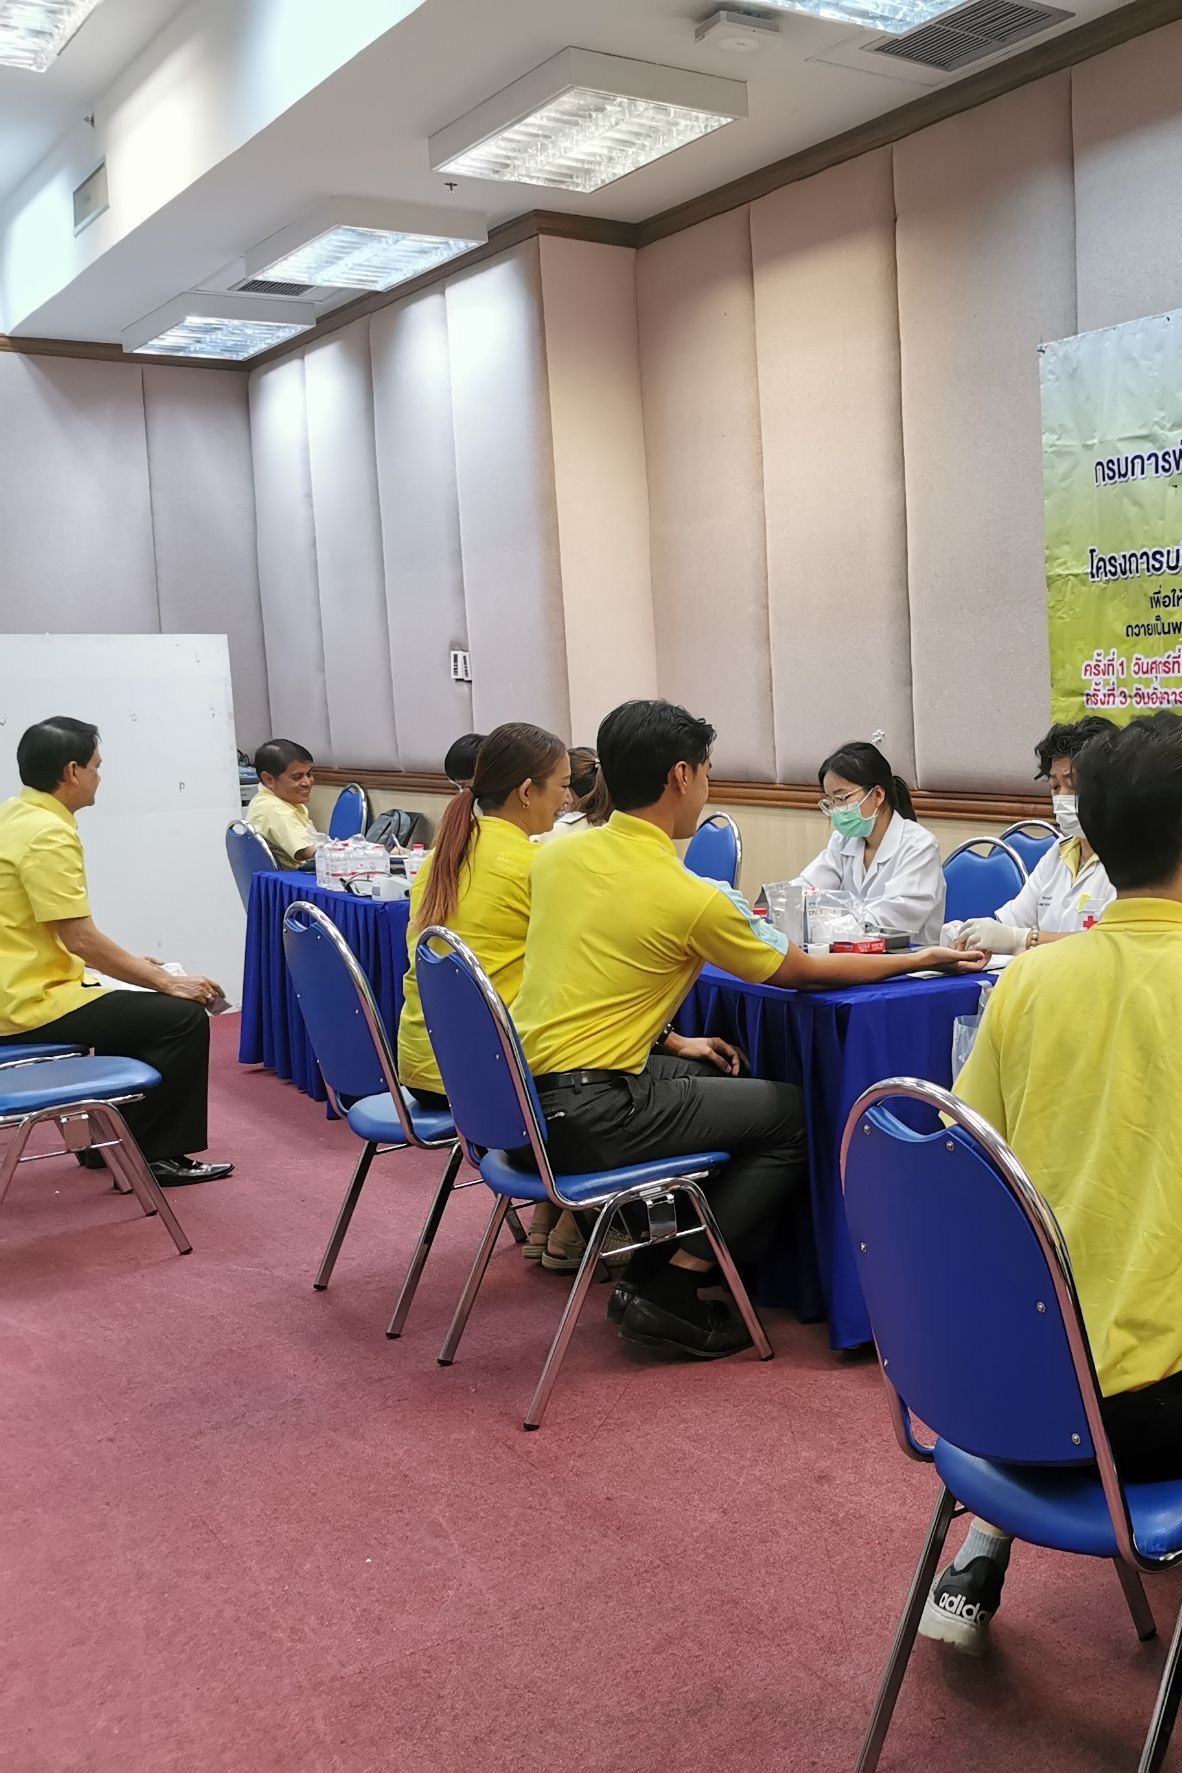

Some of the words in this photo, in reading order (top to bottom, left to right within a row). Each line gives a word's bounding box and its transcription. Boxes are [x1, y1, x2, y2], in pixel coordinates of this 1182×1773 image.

[1084, 651, 1115, 677] ครั้งที่
[1119, 661, 1125, 676] 1
[1133, 648, 1181, 681] วันศุกร์ที่
[1085, 681, 1116, 706] ครั้งที่
[1120, 690, 1128, 705] 3
